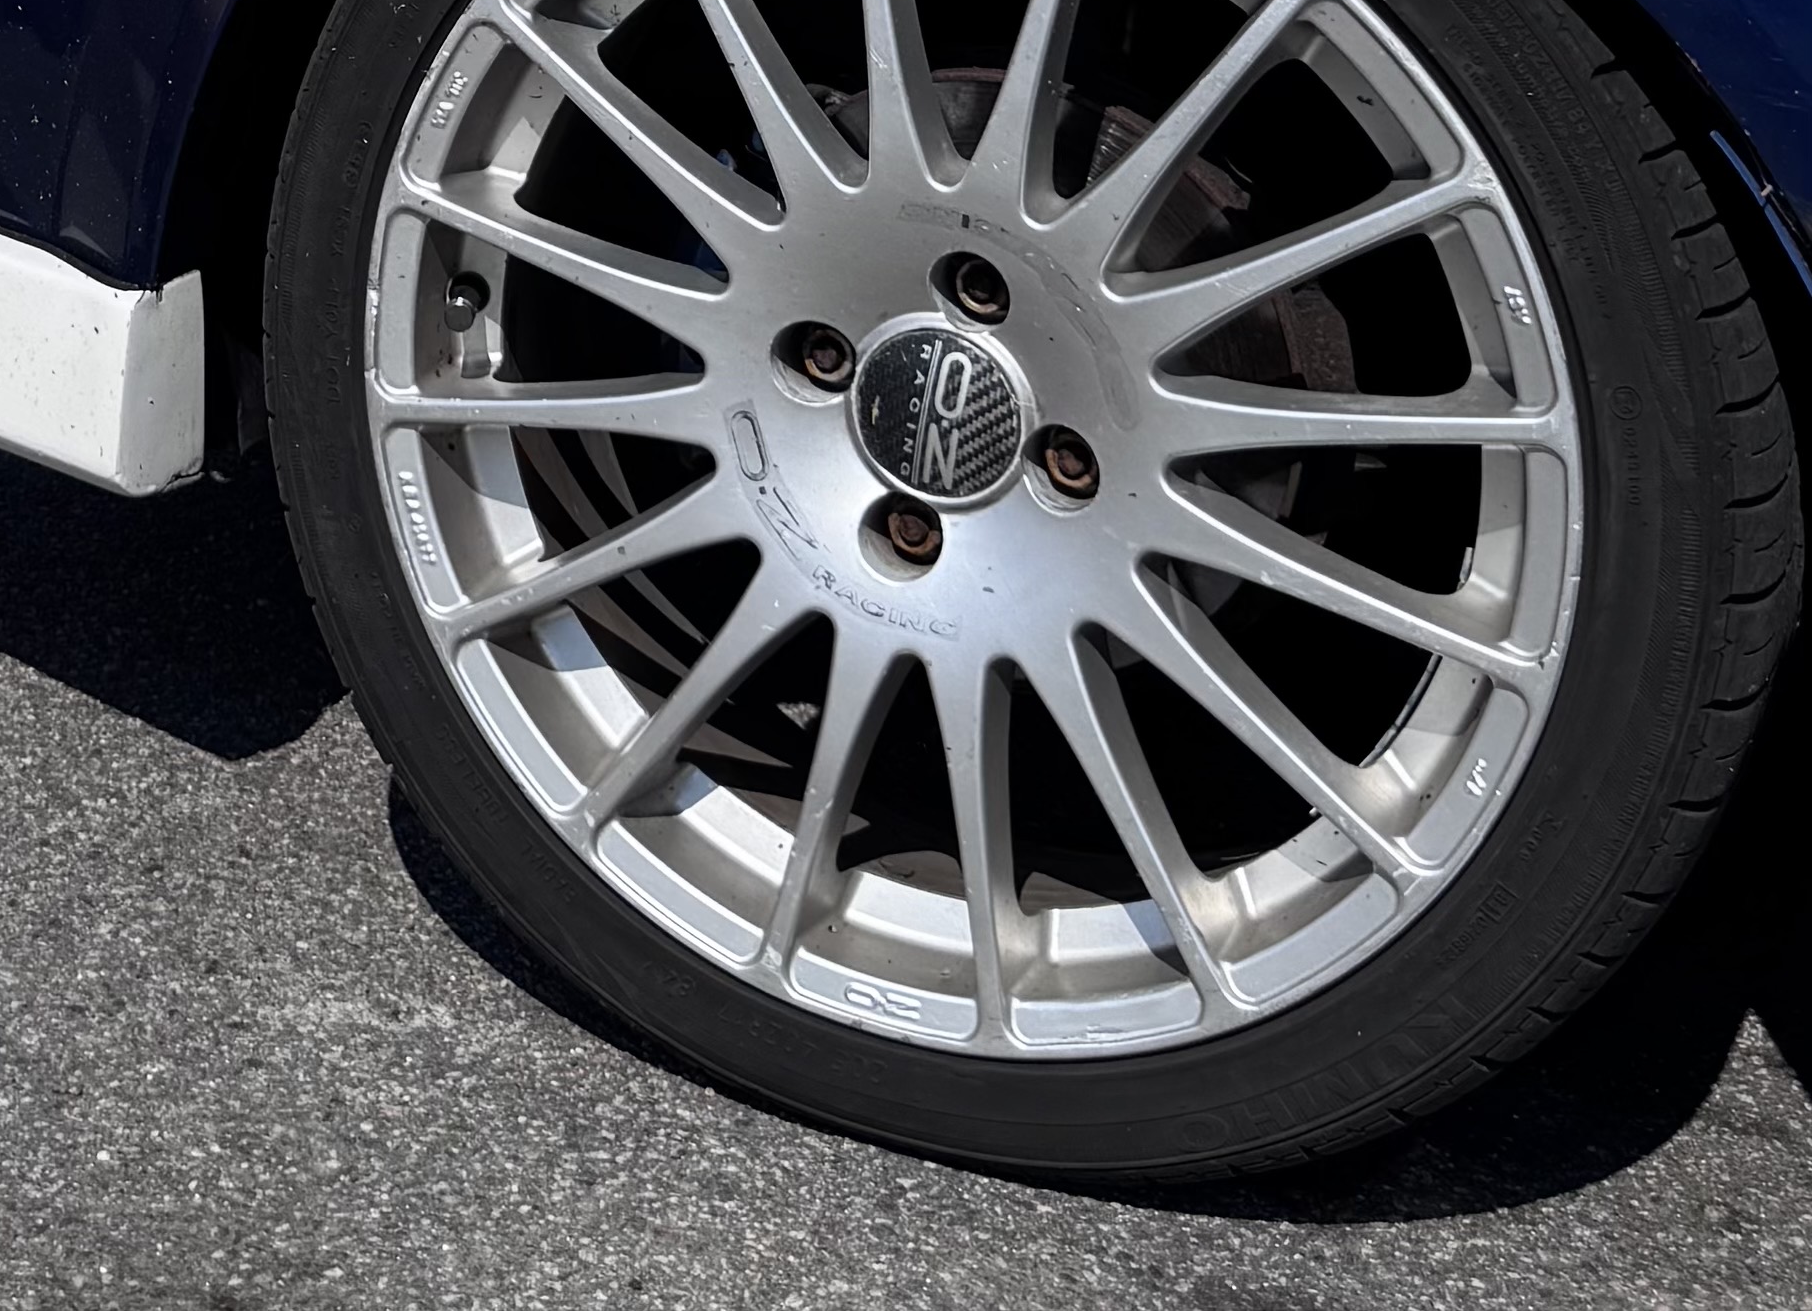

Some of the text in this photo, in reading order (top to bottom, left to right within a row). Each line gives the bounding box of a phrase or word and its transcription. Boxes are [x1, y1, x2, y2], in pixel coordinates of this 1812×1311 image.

[900, 343, 932, 476] RACING
[812, 565, 959, 637] RACING
[1175, 988, 1478, 1144] KUMHO
